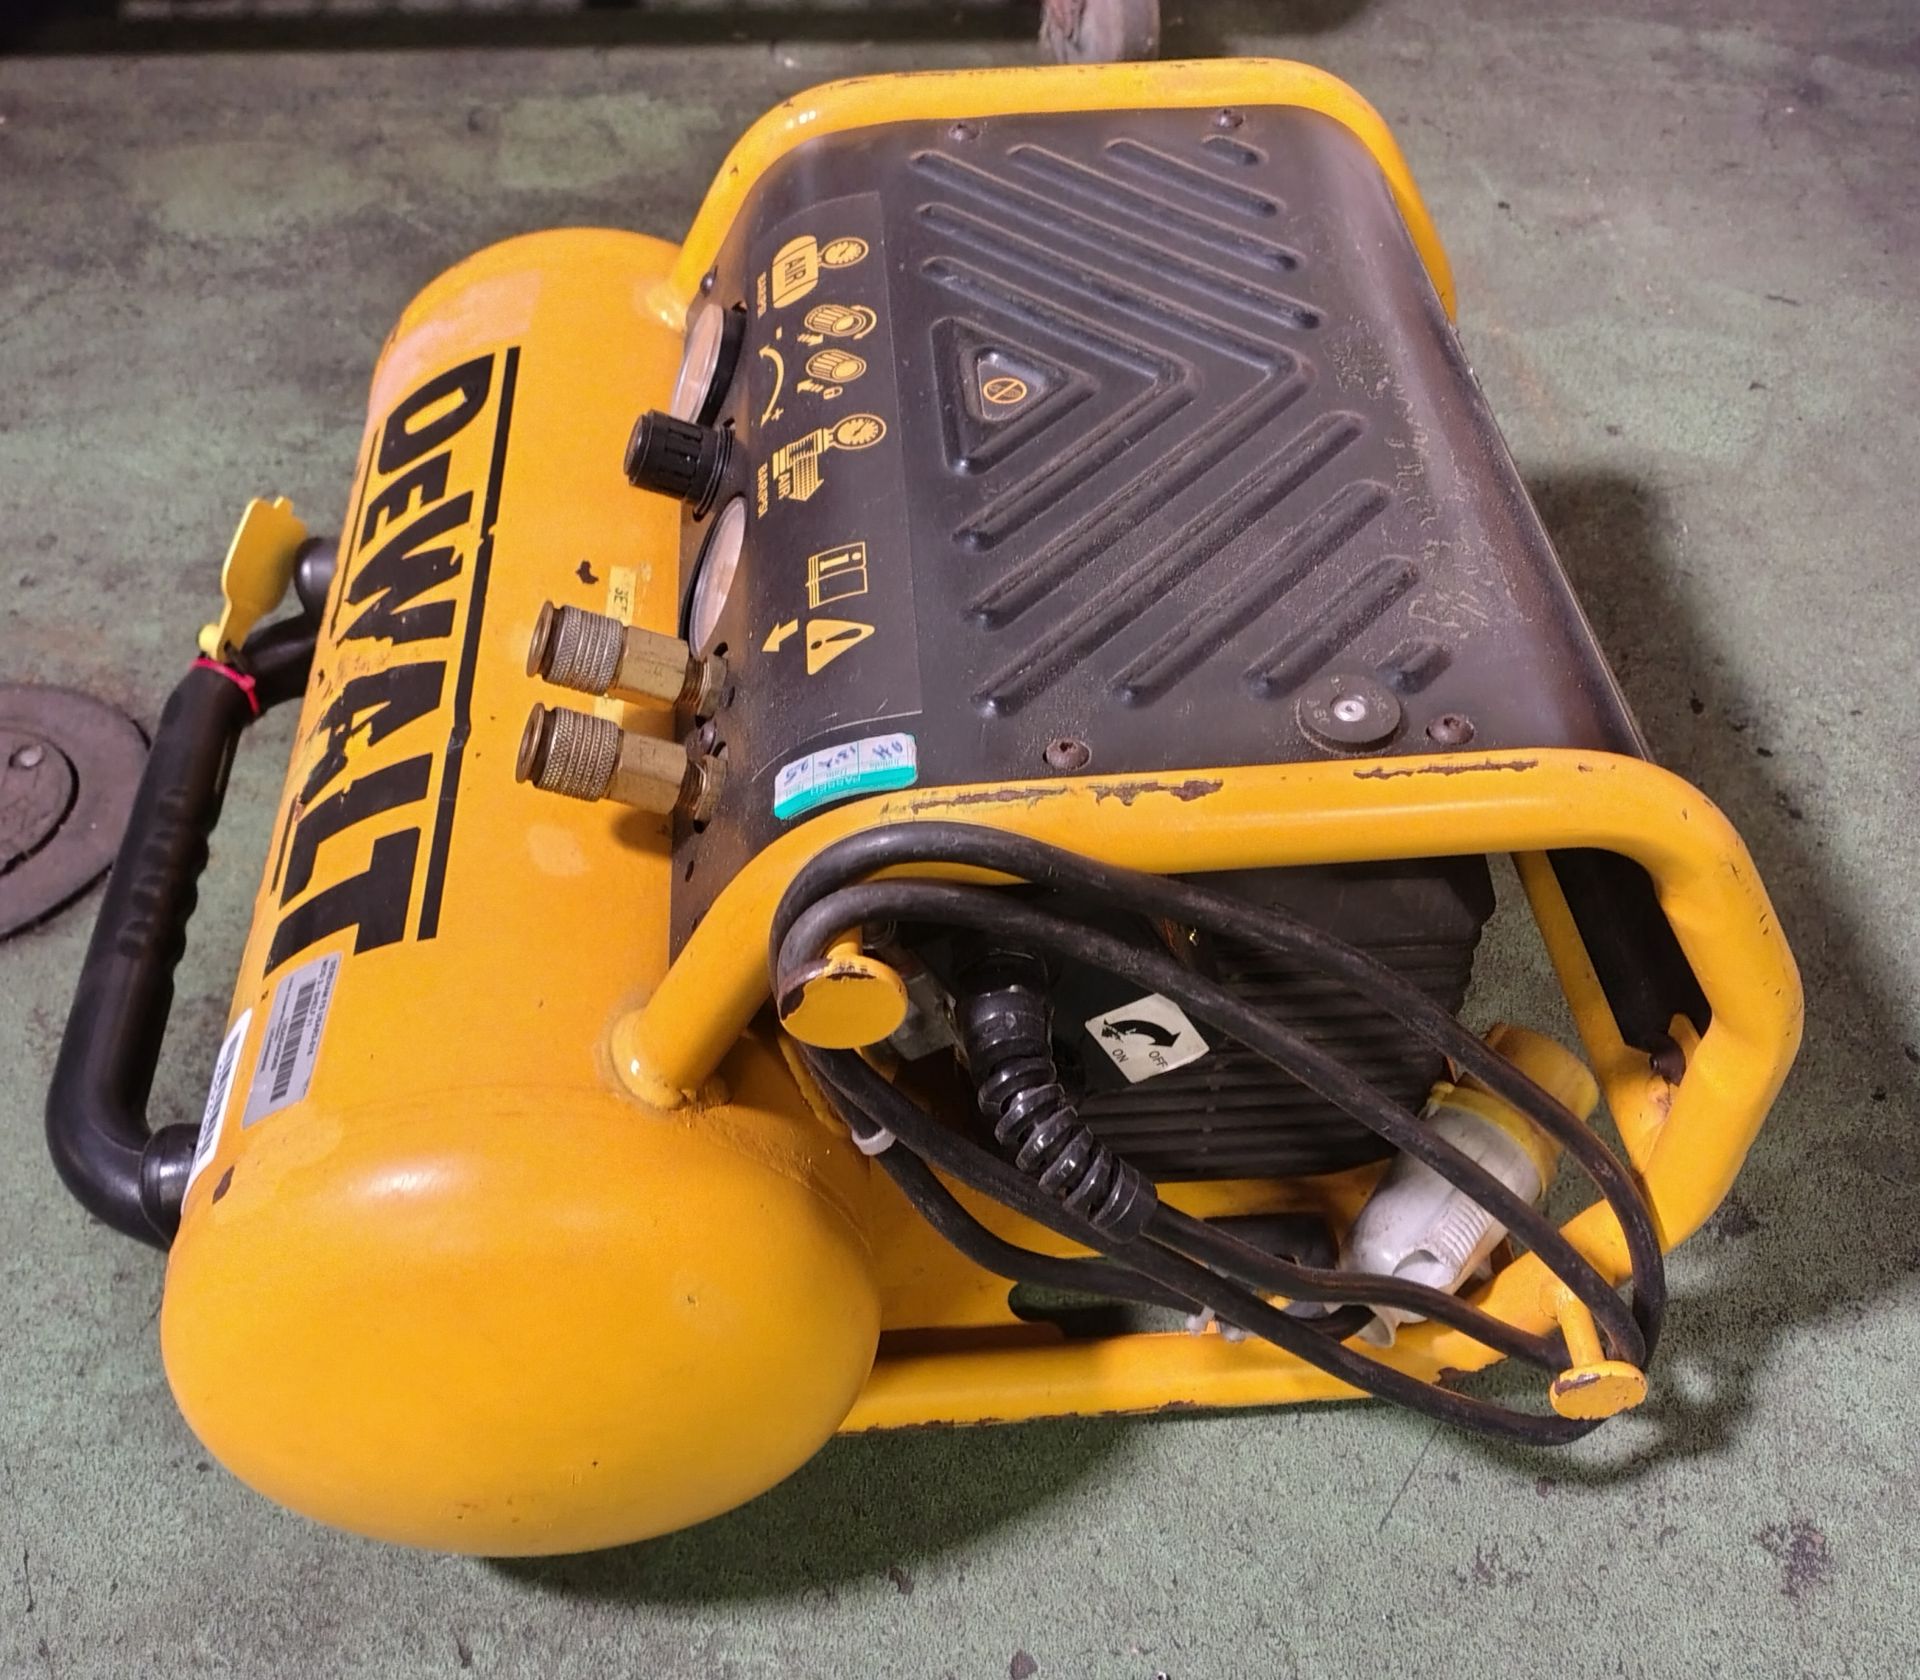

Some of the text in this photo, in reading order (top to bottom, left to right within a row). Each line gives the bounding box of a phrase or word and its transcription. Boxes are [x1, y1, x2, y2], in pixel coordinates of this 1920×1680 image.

[785, 256, 806, 287] AIR
[778, 472, 791, 500] AIR
[263, 352, 496, 981] DEWALT
[1112, 1048, 1129, 1063] ON
[1148, 1050, 1169, 1068] OFF
